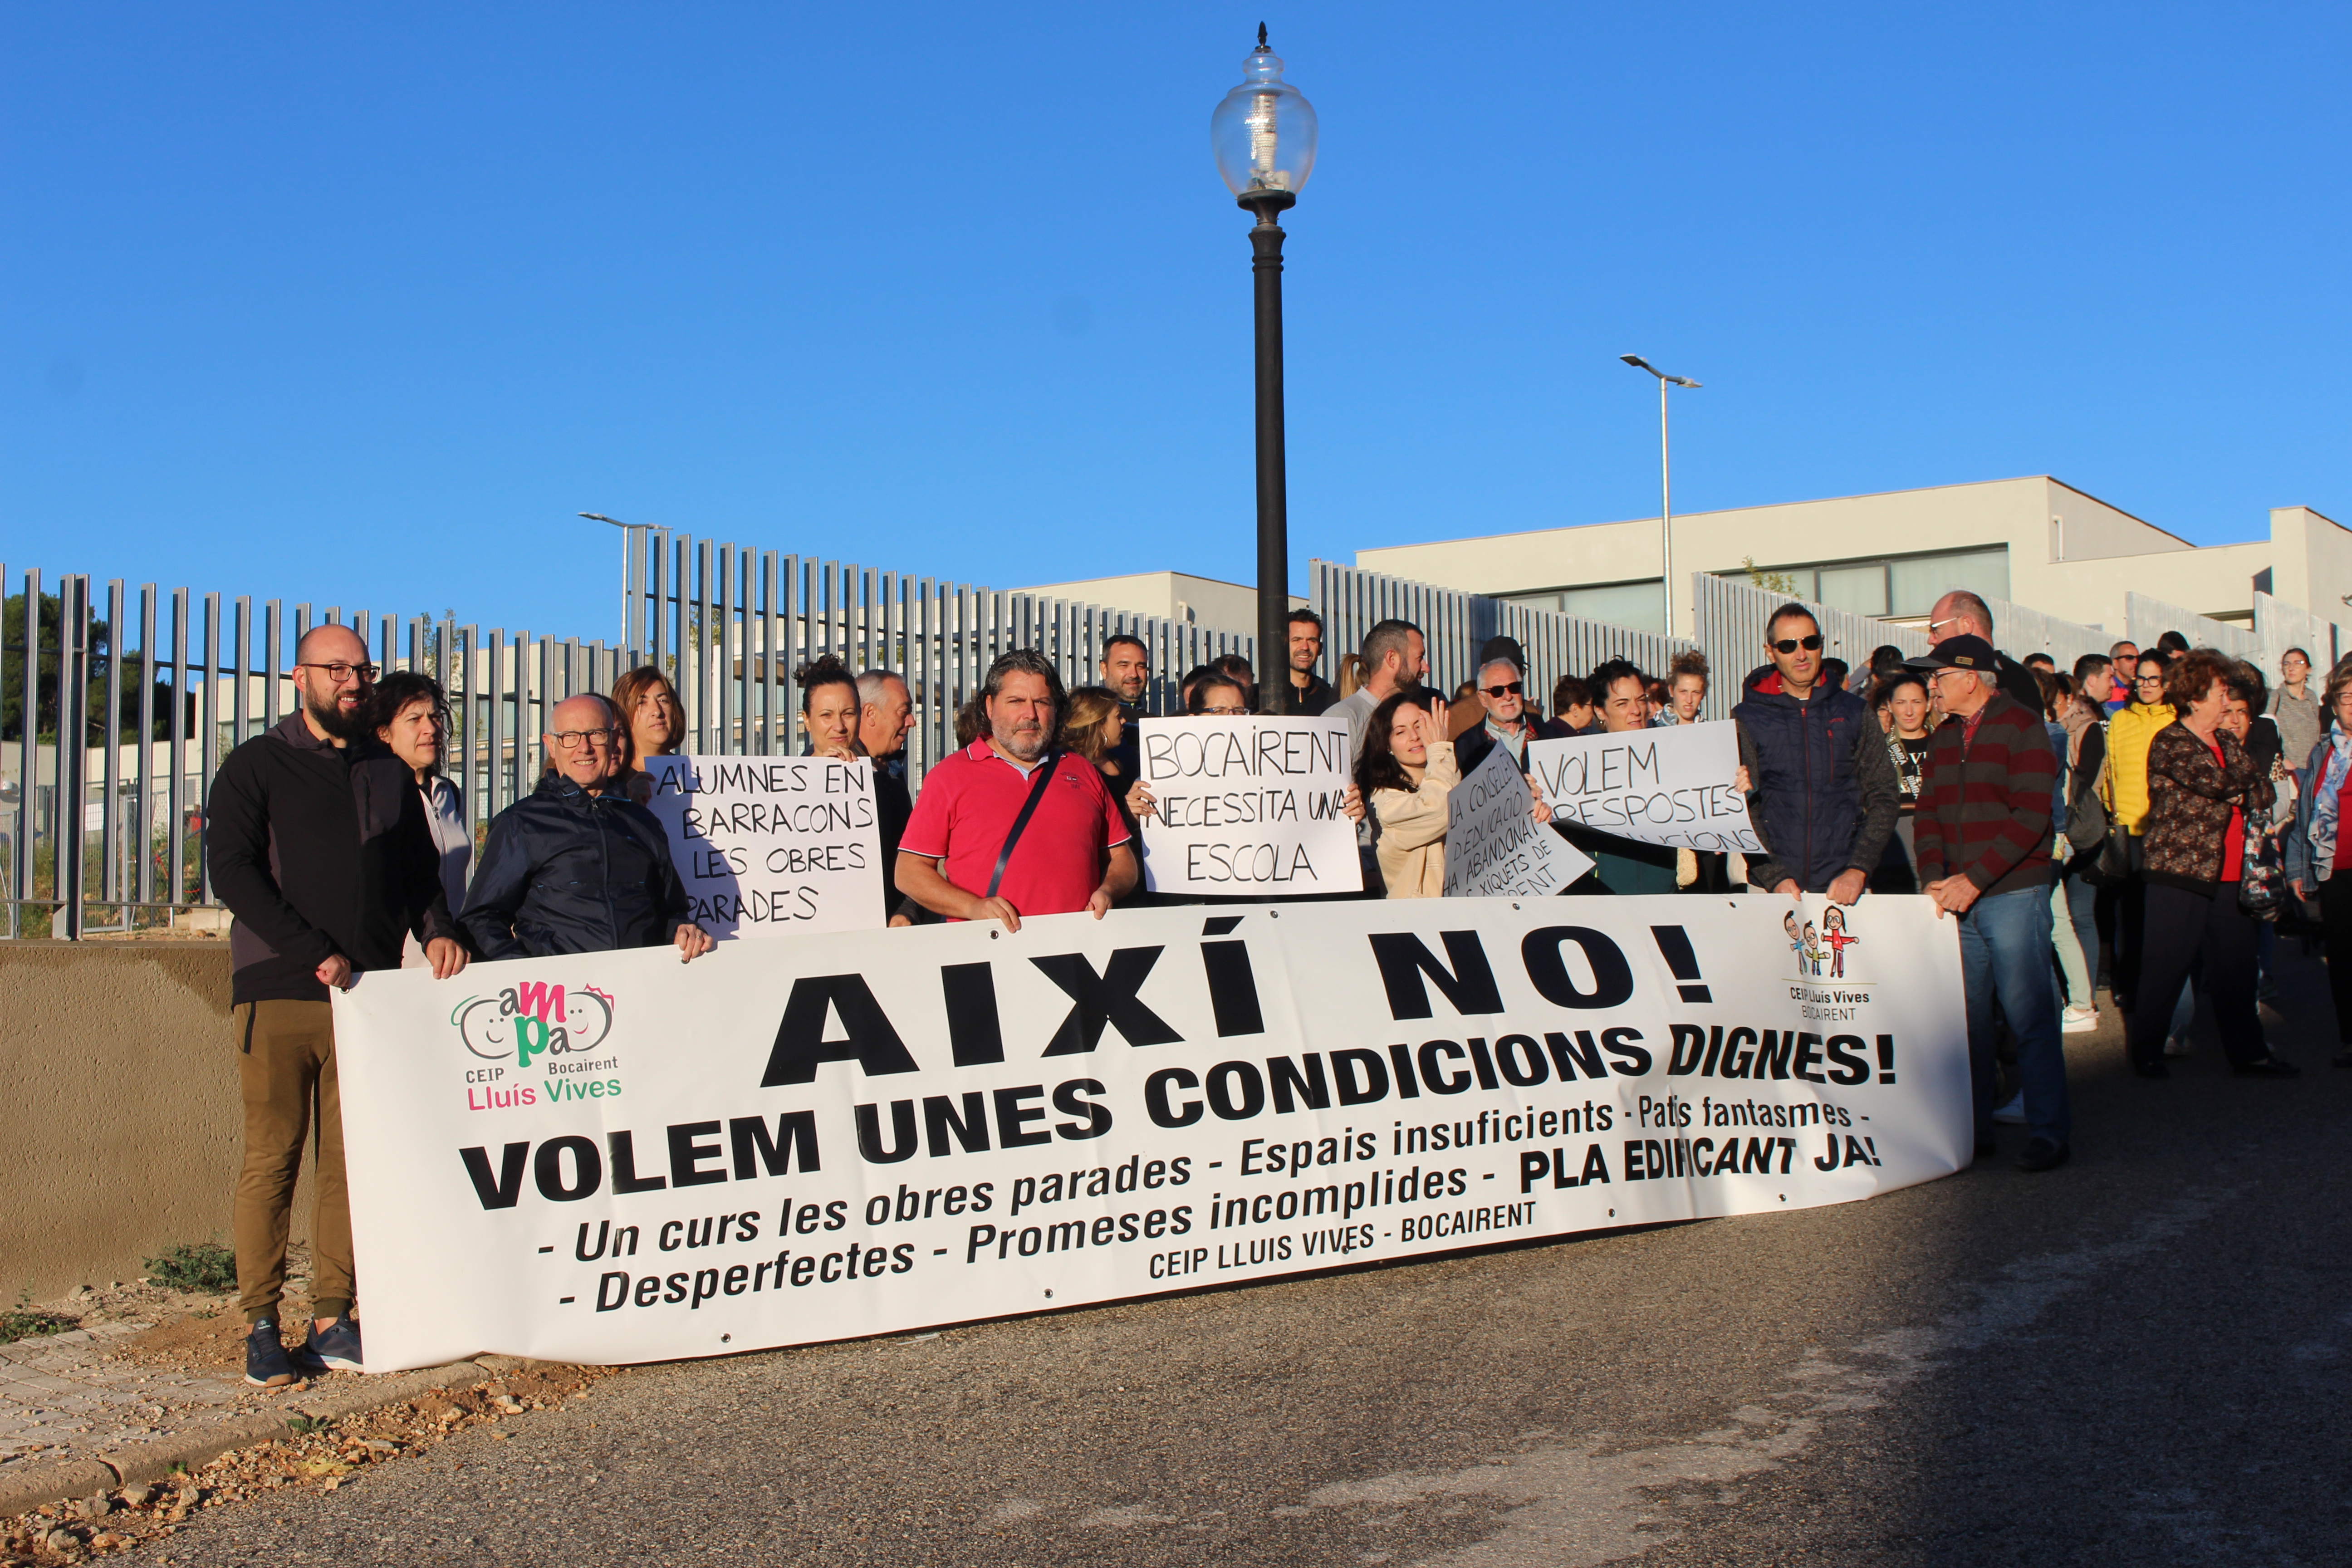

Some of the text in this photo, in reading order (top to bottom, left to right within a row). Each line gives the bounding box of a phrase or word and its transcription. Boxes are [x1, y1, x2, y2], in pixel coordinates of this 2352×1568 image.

[657, 763, 864, 795] ALUMNES EN
[1538, 741, 1660, 799] VOLEM
[683, 798, 873, 840] BARRACONS
[1450, 799, 1463, 829] LA
[694, 843, 865, 878] LES OBRES
[1188, 843, 1318, 882] ESCOLA
[1466, 808, 1539, 885] ABANDONAT
[1532, 840, 1552, 859] DE
[760, 916, 1713, 1087] AIXÍ NO!
[1790, 987, 1808, 1000] CEIP
[1833, 991, 1870, 1003] Vives
[1802, 1005, 1856, 1020] BOCAIRENT
[466, 1056, 618, 1083] CEIP Bocairent
[468, 1078, 622, 1110] Lluís Vives
[459, 1024, 1896, 1210] VOLEM UNES CONDICIONS DIGNES!
[575, 1220, 639, 1262] Un
[659, 1211, 760, 1251] curs
[779, 1198, 848, 1237] les
[866, 1183, 994, 1225] obres
[1010, 1155, 1191, 1216] parades
[1241, 1127, 1376, 1178] Espais
[1394, 1100, 1612, 1156] insuficients
[1702, 1096, 1852, 1128] fantasmes
[596, 1243, 915, 1312] Desperfectes
[967, 1206, 1192, 1264] Promeses
[1210, 1166, 1467, 1230] incomplides
[1520, 1144, 1611, 1194] PLA
[1624, 1137, 1797, 1181] EDIFICANT
[1814, 1133, 1882, 1171] JA!
[1150, 1248, 1208, 1279] CEIP
[1218, 1235, 1292, 1269] LLUIS
[1303, 1224, 1374, 1256] VIVES
[1401, 1201, 1536, 1242] BOCAIRENT
